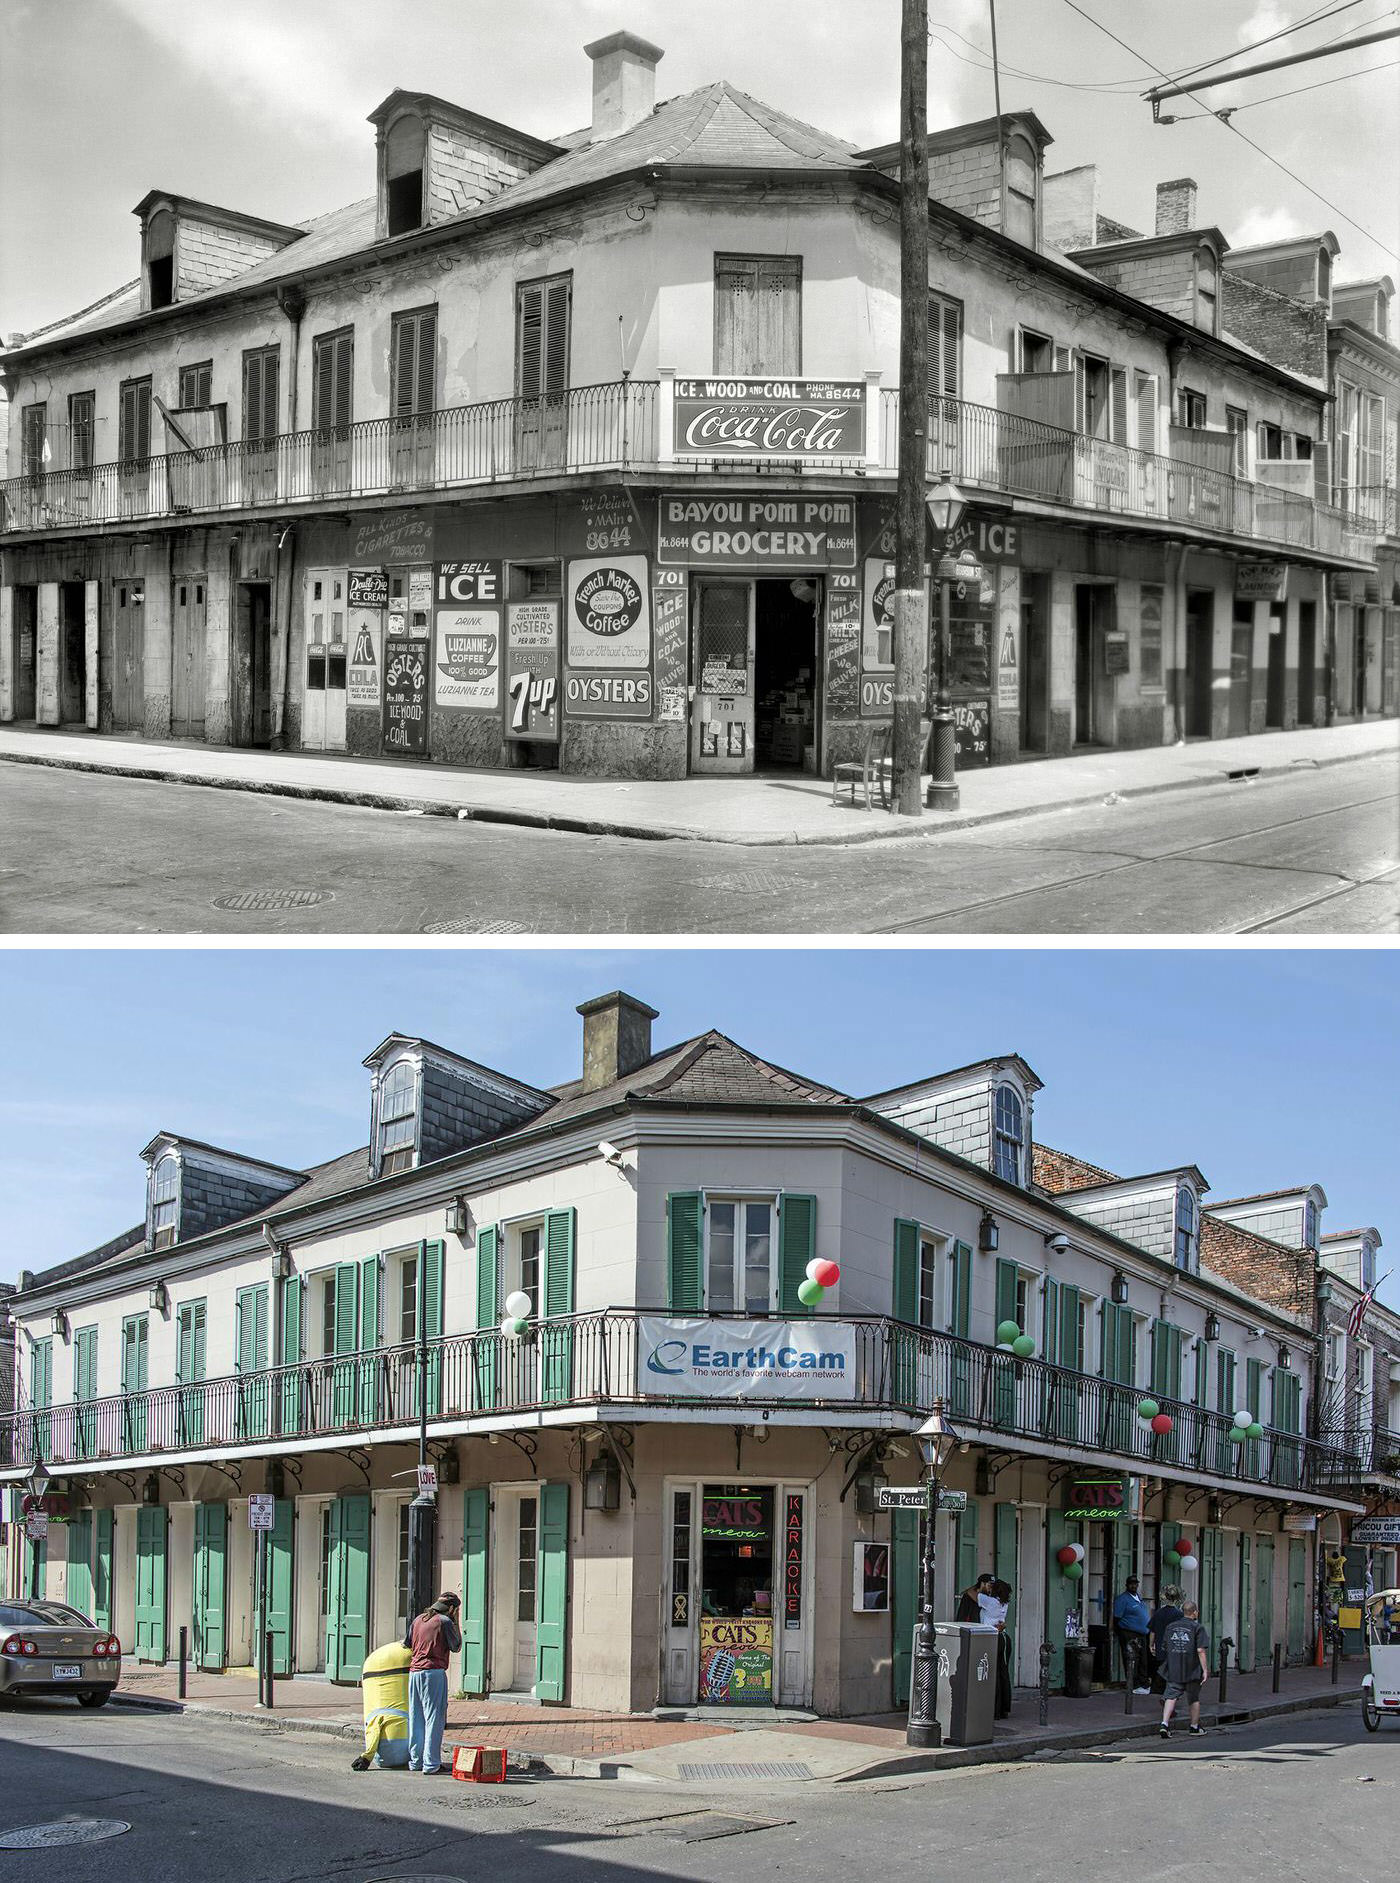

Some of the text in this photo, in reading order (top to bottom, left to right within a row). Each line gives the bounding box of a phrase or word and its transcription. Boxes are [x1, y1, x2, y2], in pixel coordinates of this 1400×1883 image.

[674, 381, 801, 399] ICE WOOD AND COAL
[806, 383, 835, 391] PHONE
[729, 406, 777, 414] DRINK
[685, 406, 850, 450] Coca-Cola
[668, 502, 850, 523] BAYOU POM POM
[586, 526, 632, 550] 8644
[691, 531, 827, 555] GROCERY
[945, 522, 1017, 555] SELL ICE
[390, 544, 426, 558] TOBACCO
[440, 562, 492, 574] WE SELL
[438, 574, 497, 601] ICE
[657, 571, 684, 585] 701
[832, 575, 857, 587] 701
[349, 591, 387, 602] ICE CREAM
[576, 570, 640, 607] French Market
[516, 612, 551, 620] CULTIVATED
[657, 593, 683, 620] ICE
[831, 599, 859, 622] MILK
[454, 617, 482, 626] DRINK
[511, 620, 554, 636] OYSTERS
[586, 611, 630, 632] Coffee
[829, 628, 857, 638] MILK
[354, 635, 372, 661] RC
[448, 637, 488, 652] LUZIANNE
[658, 638, 686, 660] COAL
[828, 639, 859, 660] CHEESE
[450, 654, 484, 663] COFFEE
[349, 669, 378, 686] COLA
[386, 654, 425, 690] OYSTERS
[468, 667, 488, 676] GOOD
[656, 663, 685, 690] DELIVER
[829, 665, 858, 690] DELIVER
[437, 685, 495, 696] LUZIANNE TEA
[567, 679, 649, 703] OYSTERS
[718, 703, 734, 711] 701
[390, 727, 411, 747] COAL
[692, 1345, 845, 1370] EarthCam
[692, 1368, 845, 1379] The world's favorite webcam network
[420, 1472, 436, 1484] LOVE
[881, 1494, 925, 1504] St. Peter
[1071, 1486, 1123, 1507] CATS
[703, 1500, 763, 1527] CATS
[1065, 1508, 1123, 1517] meow
[703, 1528, 765, 1538] meow
[787, 1496, 800, 1612] KARAOKE
[712, 1624, 758, 1643] CATS
[734, 1668, 747, 1688] 3
[762, 1669, 771, 1689] 1
